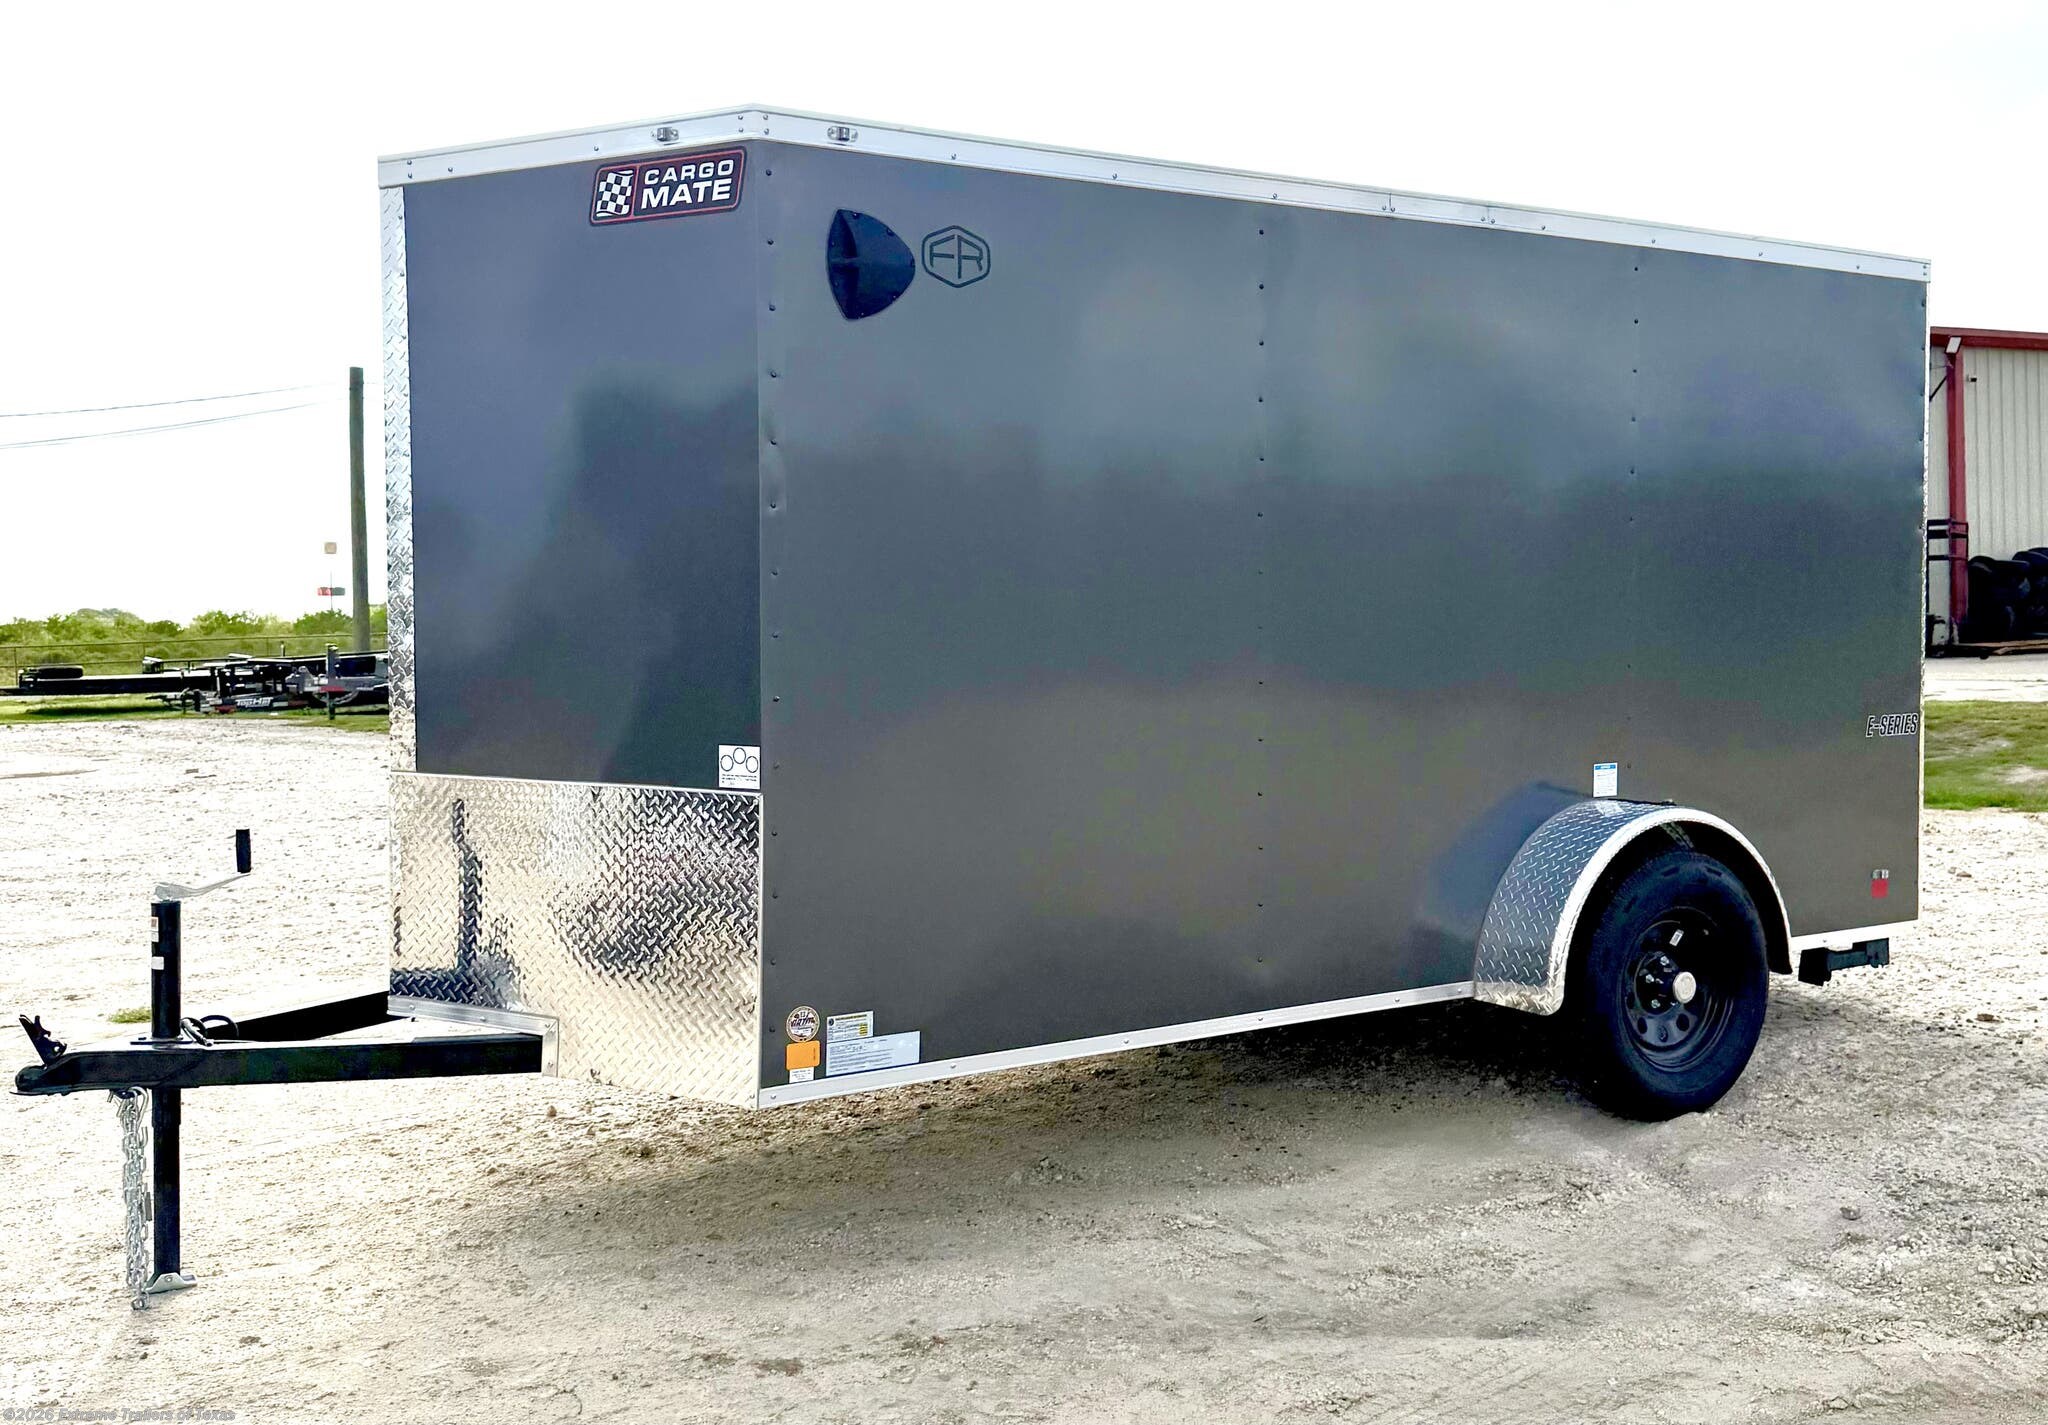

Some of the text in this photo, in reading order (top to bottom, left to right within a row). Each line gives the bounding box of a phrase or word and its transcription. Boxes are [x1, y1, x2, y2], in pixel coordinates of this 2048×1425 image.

[644, 159, 735, 186] CARGO
[640, 177, 733, 210] MATE
[1865, 712, 1919, 738] E-SERIES
